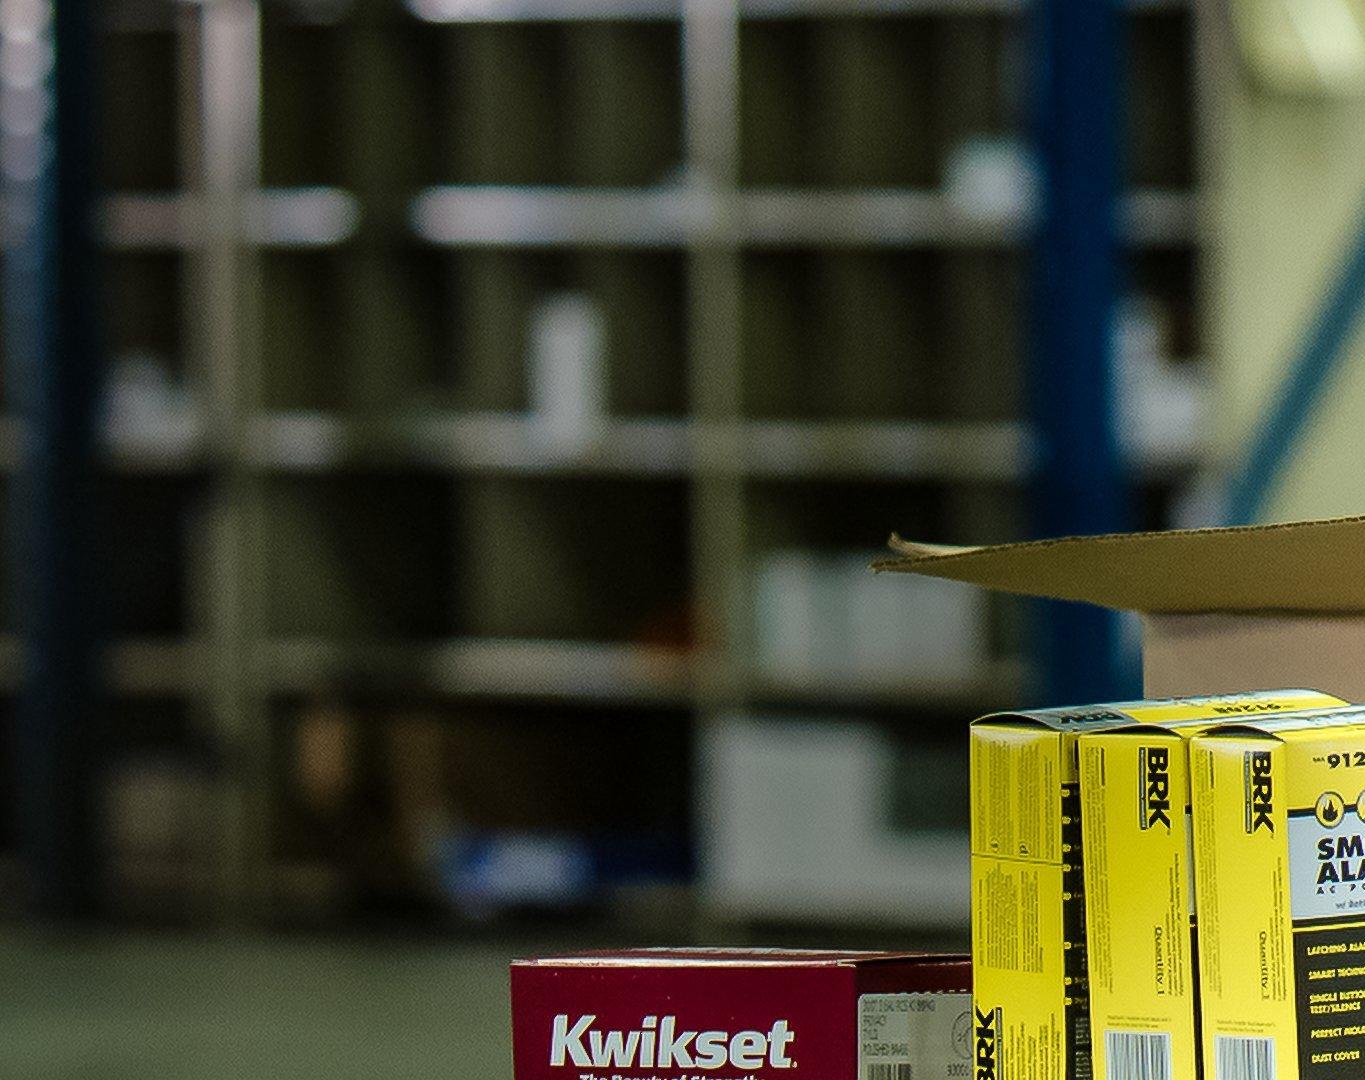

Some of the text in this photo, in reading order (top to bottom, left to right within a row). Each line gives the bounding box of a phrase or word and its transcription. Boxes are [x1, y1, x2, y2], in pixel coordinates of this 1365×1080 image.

[1146, 746, 1171, 830] BRK
[1252, 751, 1275, 834] BRK
[550, 1014, 796, 1070] Kwikset
